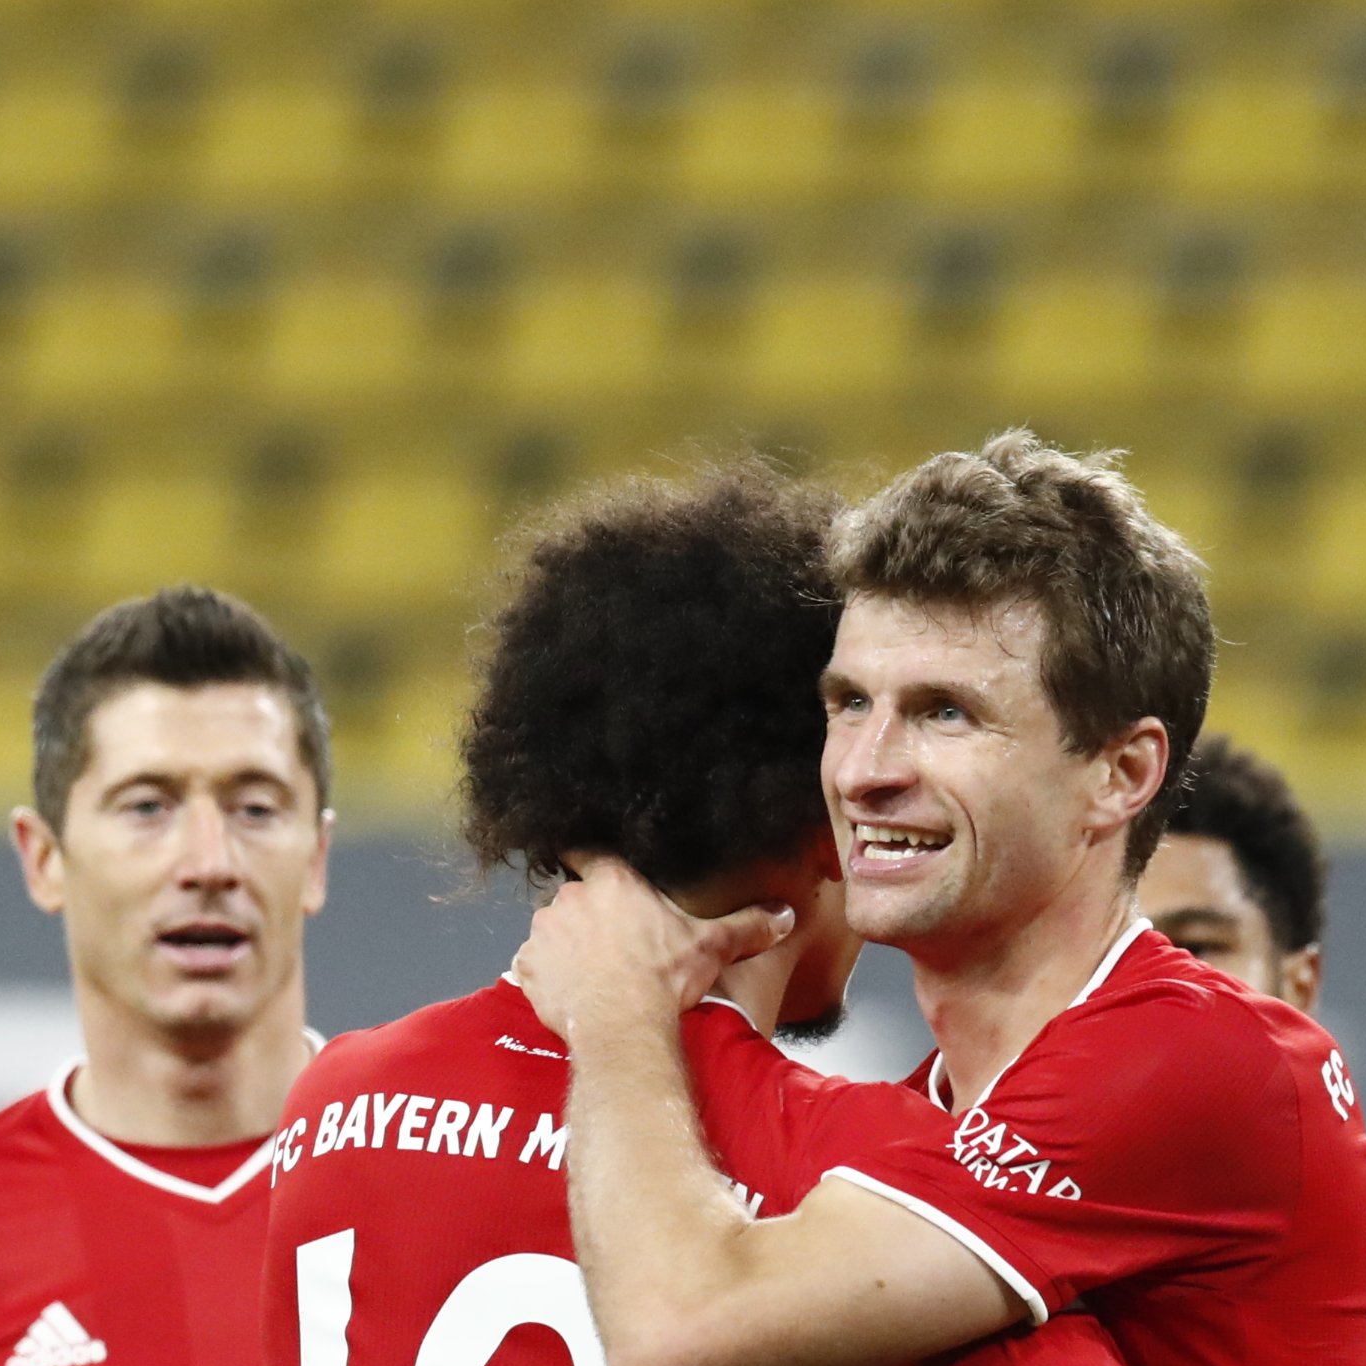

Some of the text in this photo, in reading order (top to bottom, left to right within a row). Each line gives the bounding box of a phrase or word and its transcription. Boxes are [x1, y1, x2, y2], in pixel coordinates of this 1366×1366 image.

[495, 1034, 528, 1052] Mia
[1321, 1049, 1355, 1121] FC
[270, 1117, 307, 1189] FC
[312, 1092, 514, 1159] BAYERN
